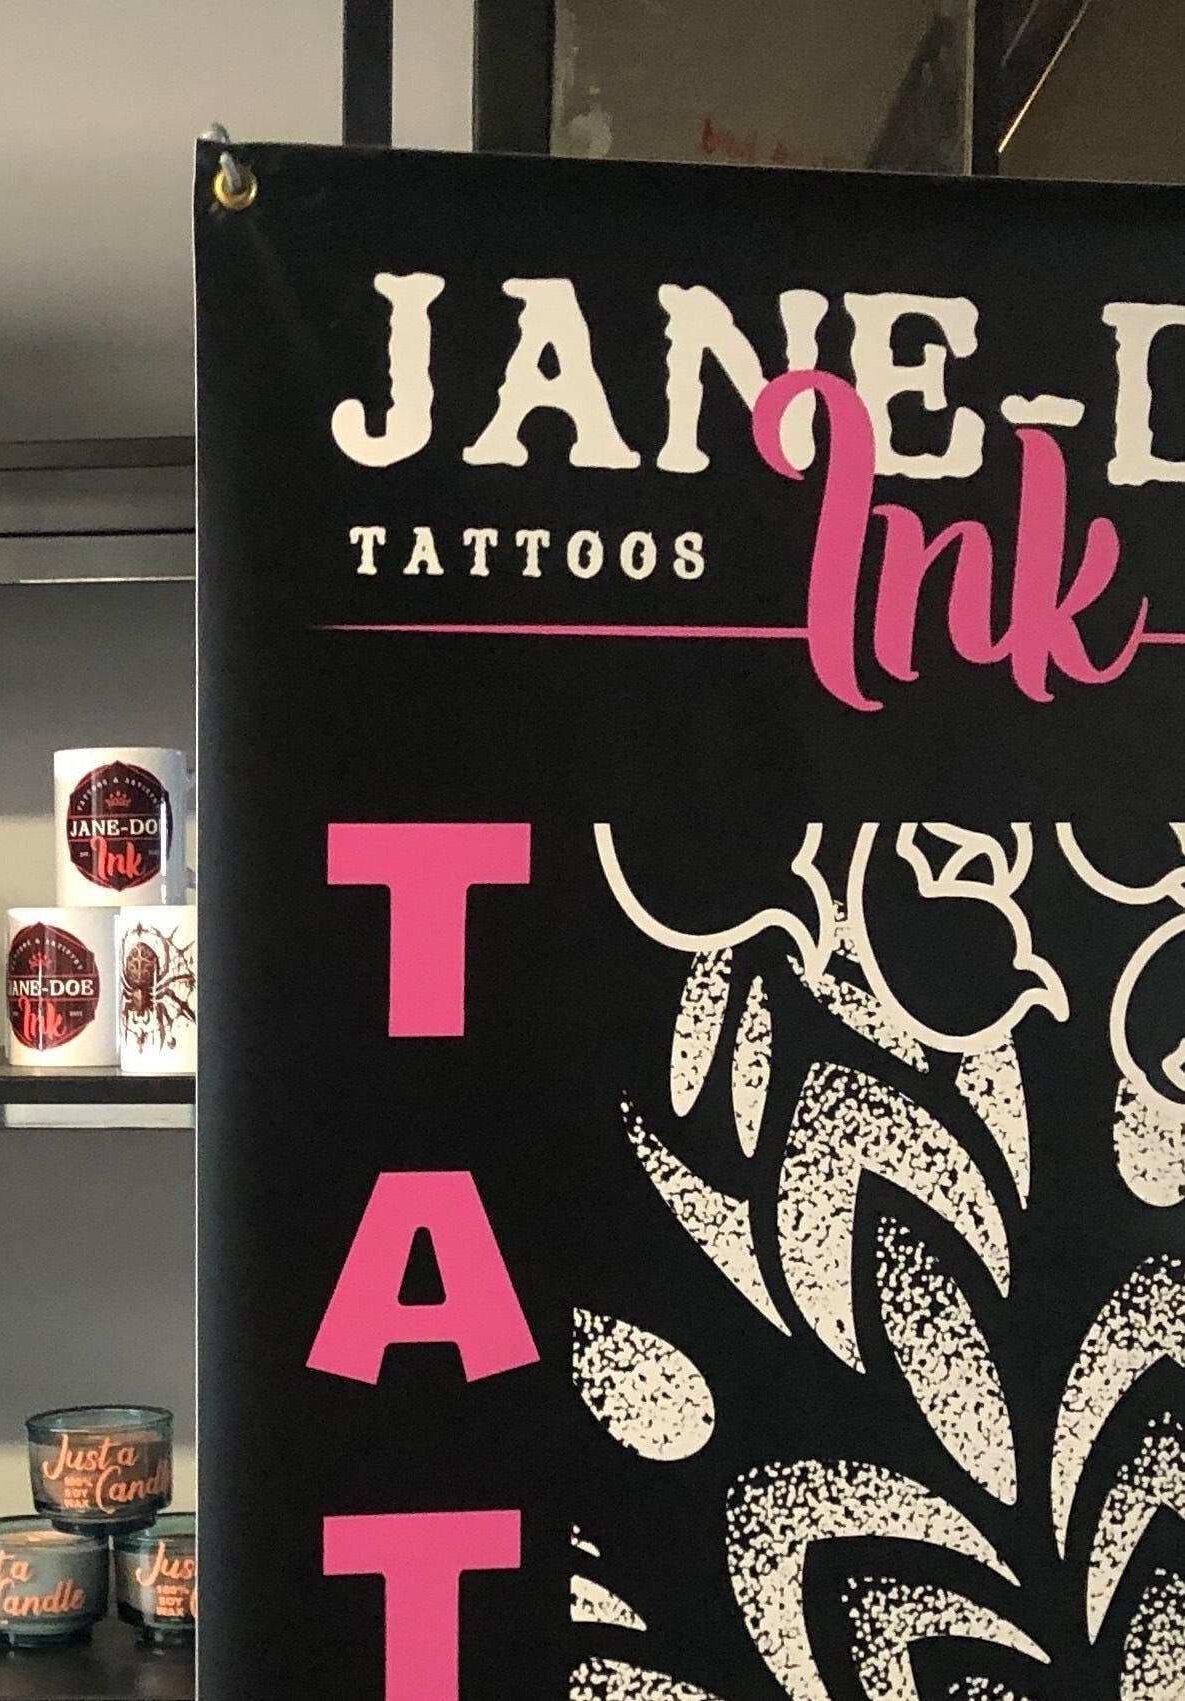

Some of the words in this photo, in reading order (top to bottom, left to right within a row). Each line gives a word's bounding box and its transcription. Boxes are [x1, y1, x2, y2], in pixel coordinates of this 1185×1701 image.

[348, 524, 706, 581] TATTOOS
[752, 369, 1148, 712] Ink
[70, 818, 162, 837] JANE-DO
[89, 836, 142, 880] Ink
[42, 1433, 122, 1480] Just
[117, 1447, 139, 1467] a
[10, 1560, 32, 1582] a
